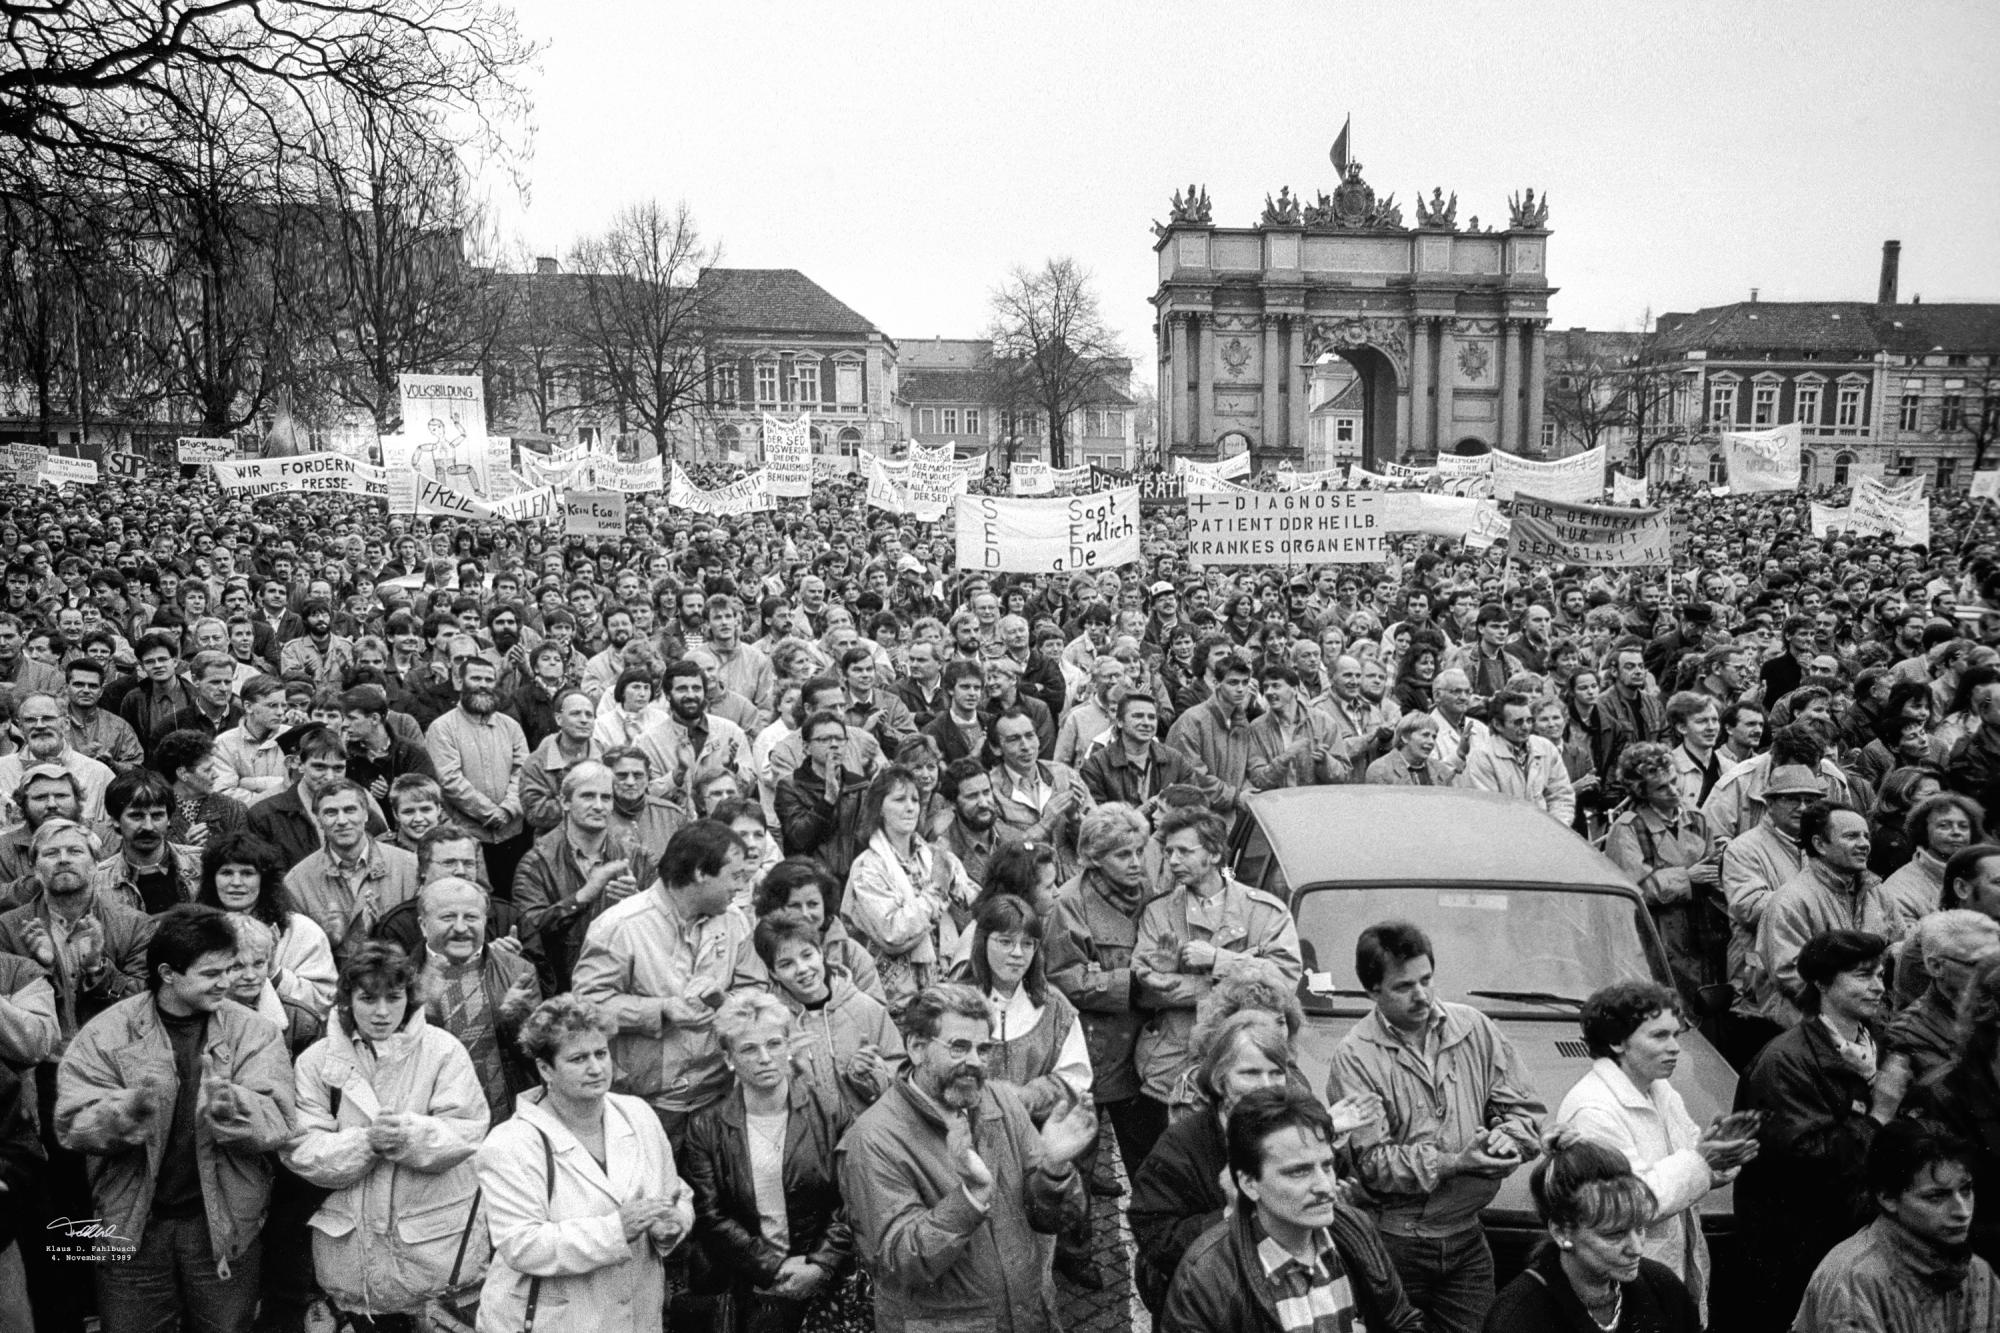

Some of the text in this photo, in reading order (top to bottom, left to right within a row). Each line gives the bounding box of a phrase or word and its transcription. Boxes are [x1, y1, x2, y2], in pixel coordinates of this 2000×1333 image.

[404, 383, 473, 398] VOLKSBILDUNG
[767, 436, 806, 446] DER SED
[109, 452, 146, 478] SDP
[235, 465, 262, 478] WIR
[281, 458, 355, 476] FORDERN
[765, 461, 810, 471] SOZIALISMUS
[928, 464, 952, 472] MACHT
[914, 492, 948, 503] DER SED
[1069, 495, 1116, 523] Sagt
[598, 521, 621, 529] ISMUS
[1070, 514, 1133, 544] Endlich
[1188, 514, 1378, 532] PATIENT DDR HEILB.
[1556, 526, 1637, 544] NUR MIT
[1190, 540, 1274, 555] KRANKES
[1281, 538, 1338, 554] ORGAN
